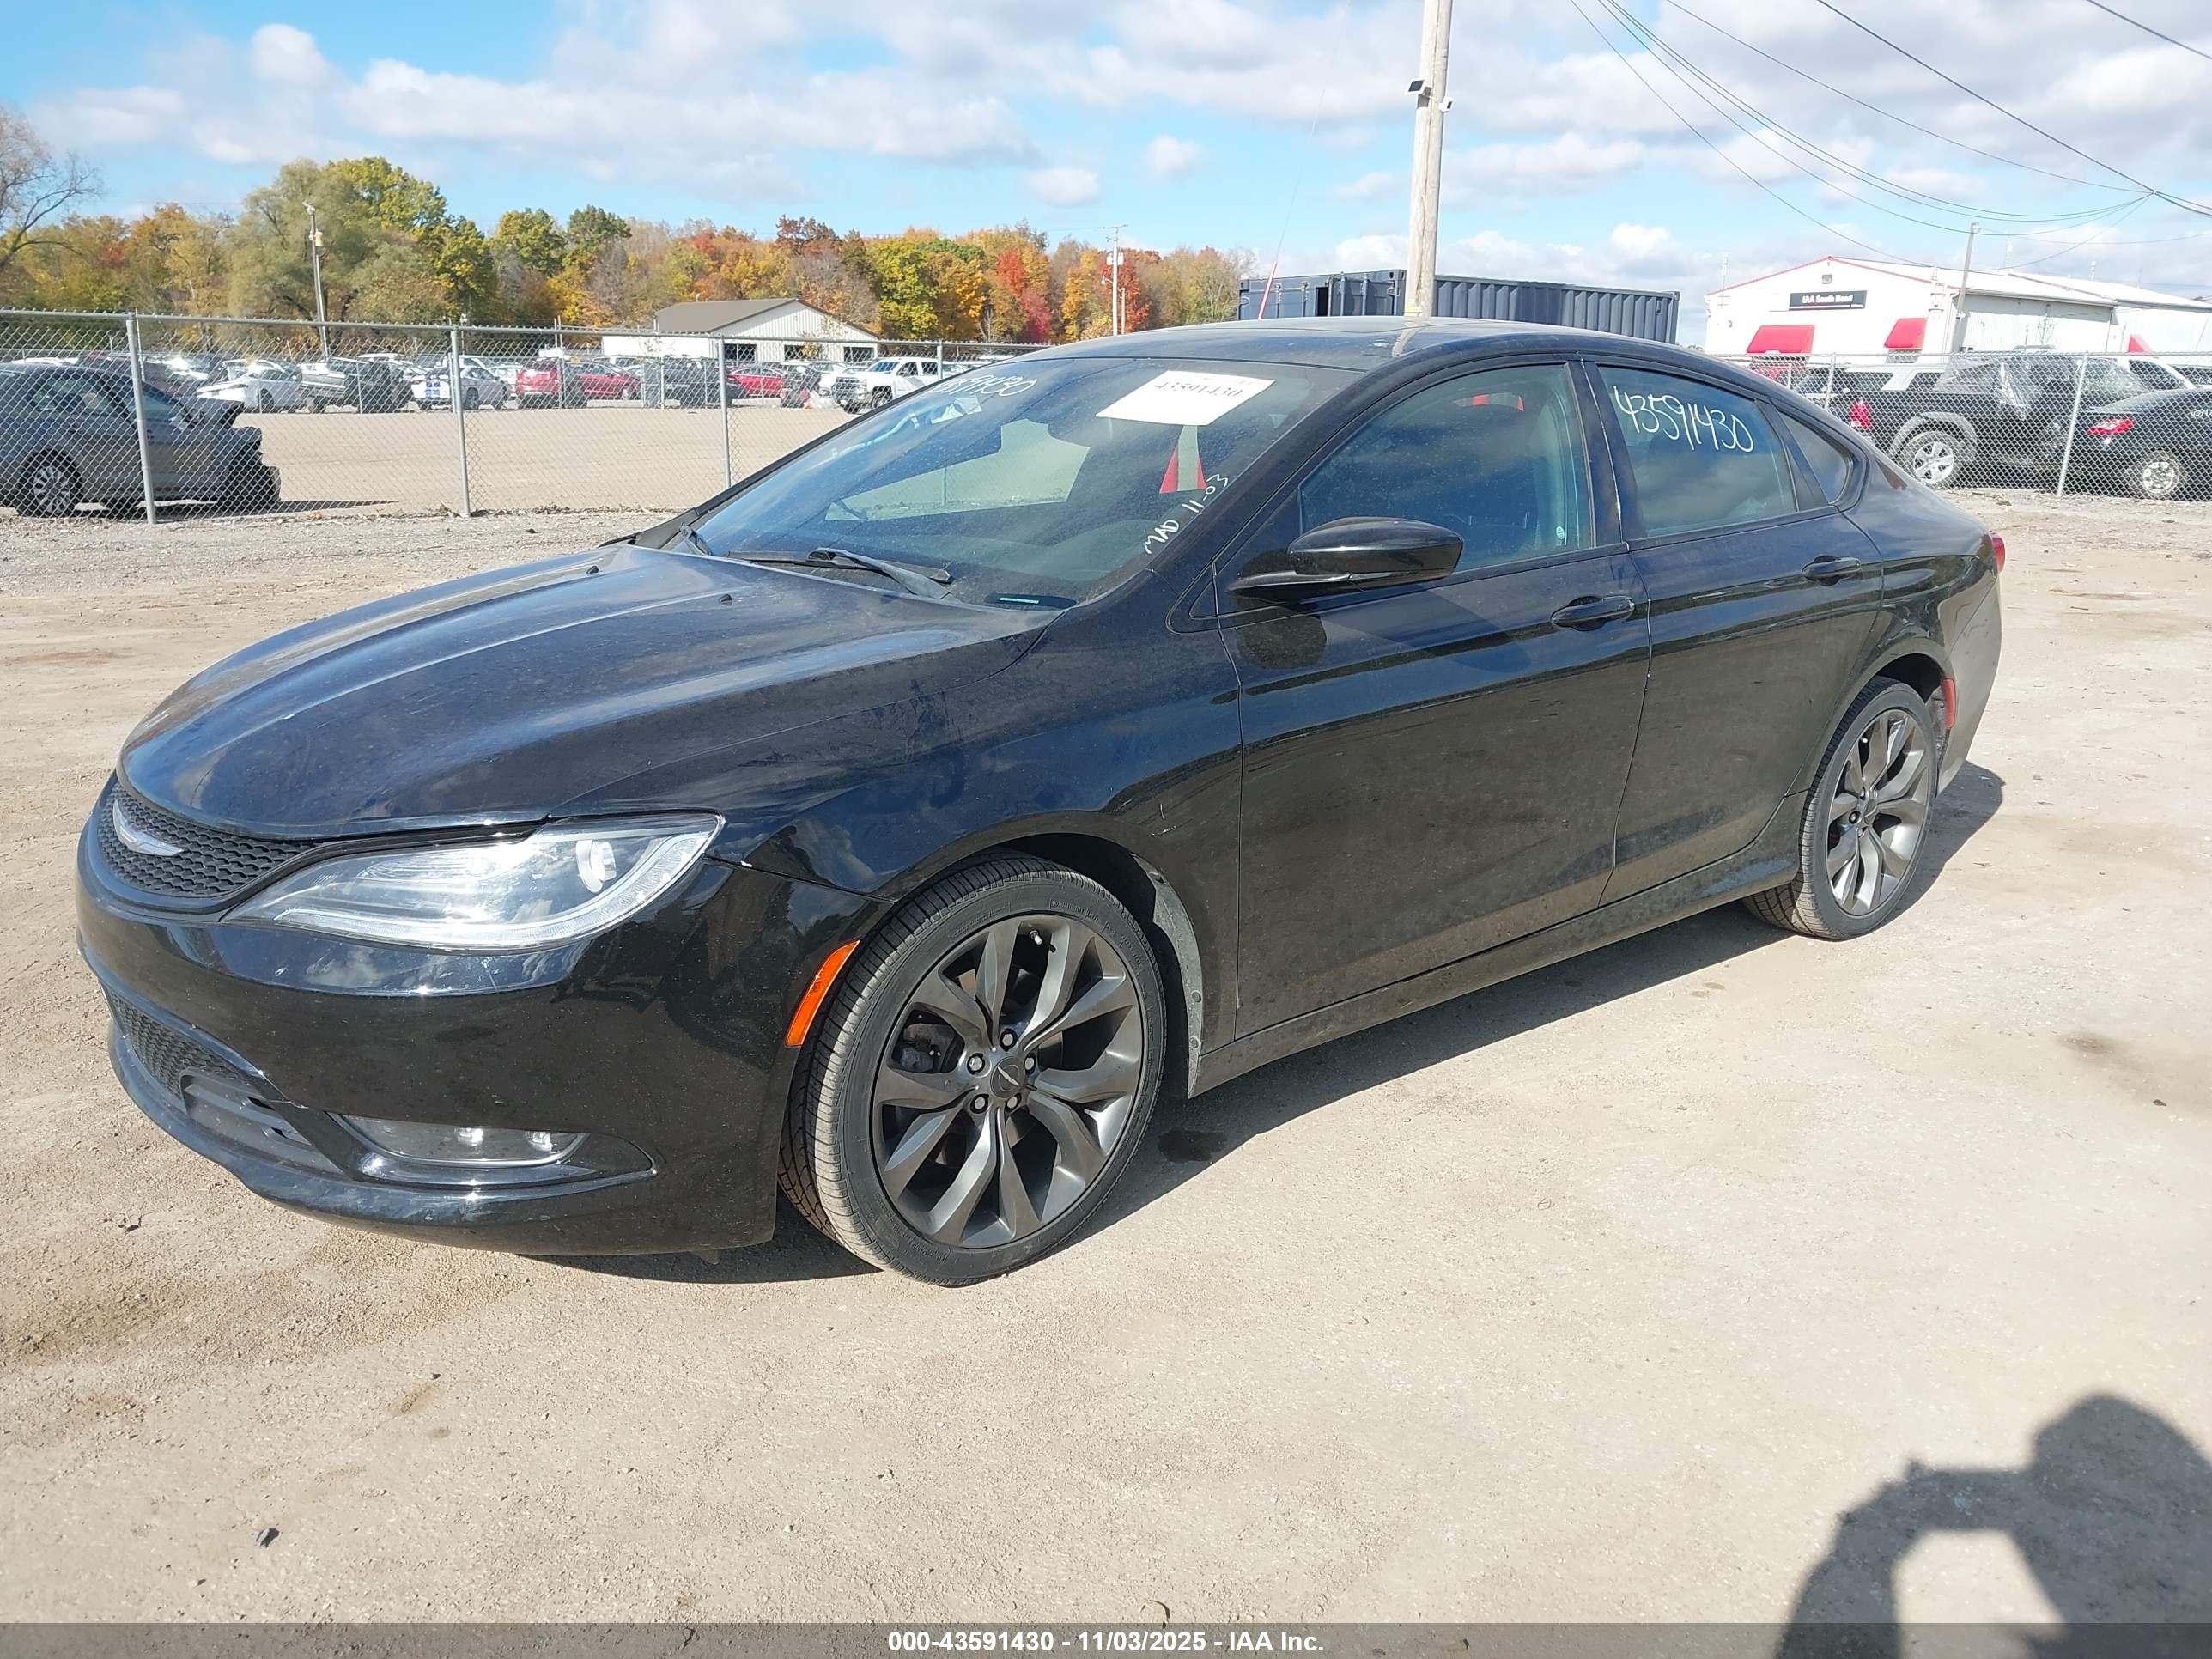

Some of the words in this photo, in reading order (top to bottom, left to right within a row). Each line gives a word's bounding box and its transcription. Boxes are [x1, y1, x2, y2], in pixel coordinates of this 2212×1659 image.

[1802, 295, 1815, 303] IAA
[1815, 294, 1835, 303] South
[1613, 385, 1753, 453] 43591430
[1143, 520, 1180, 555] MAD
[1181, 473, 1229, 514] 11-03
